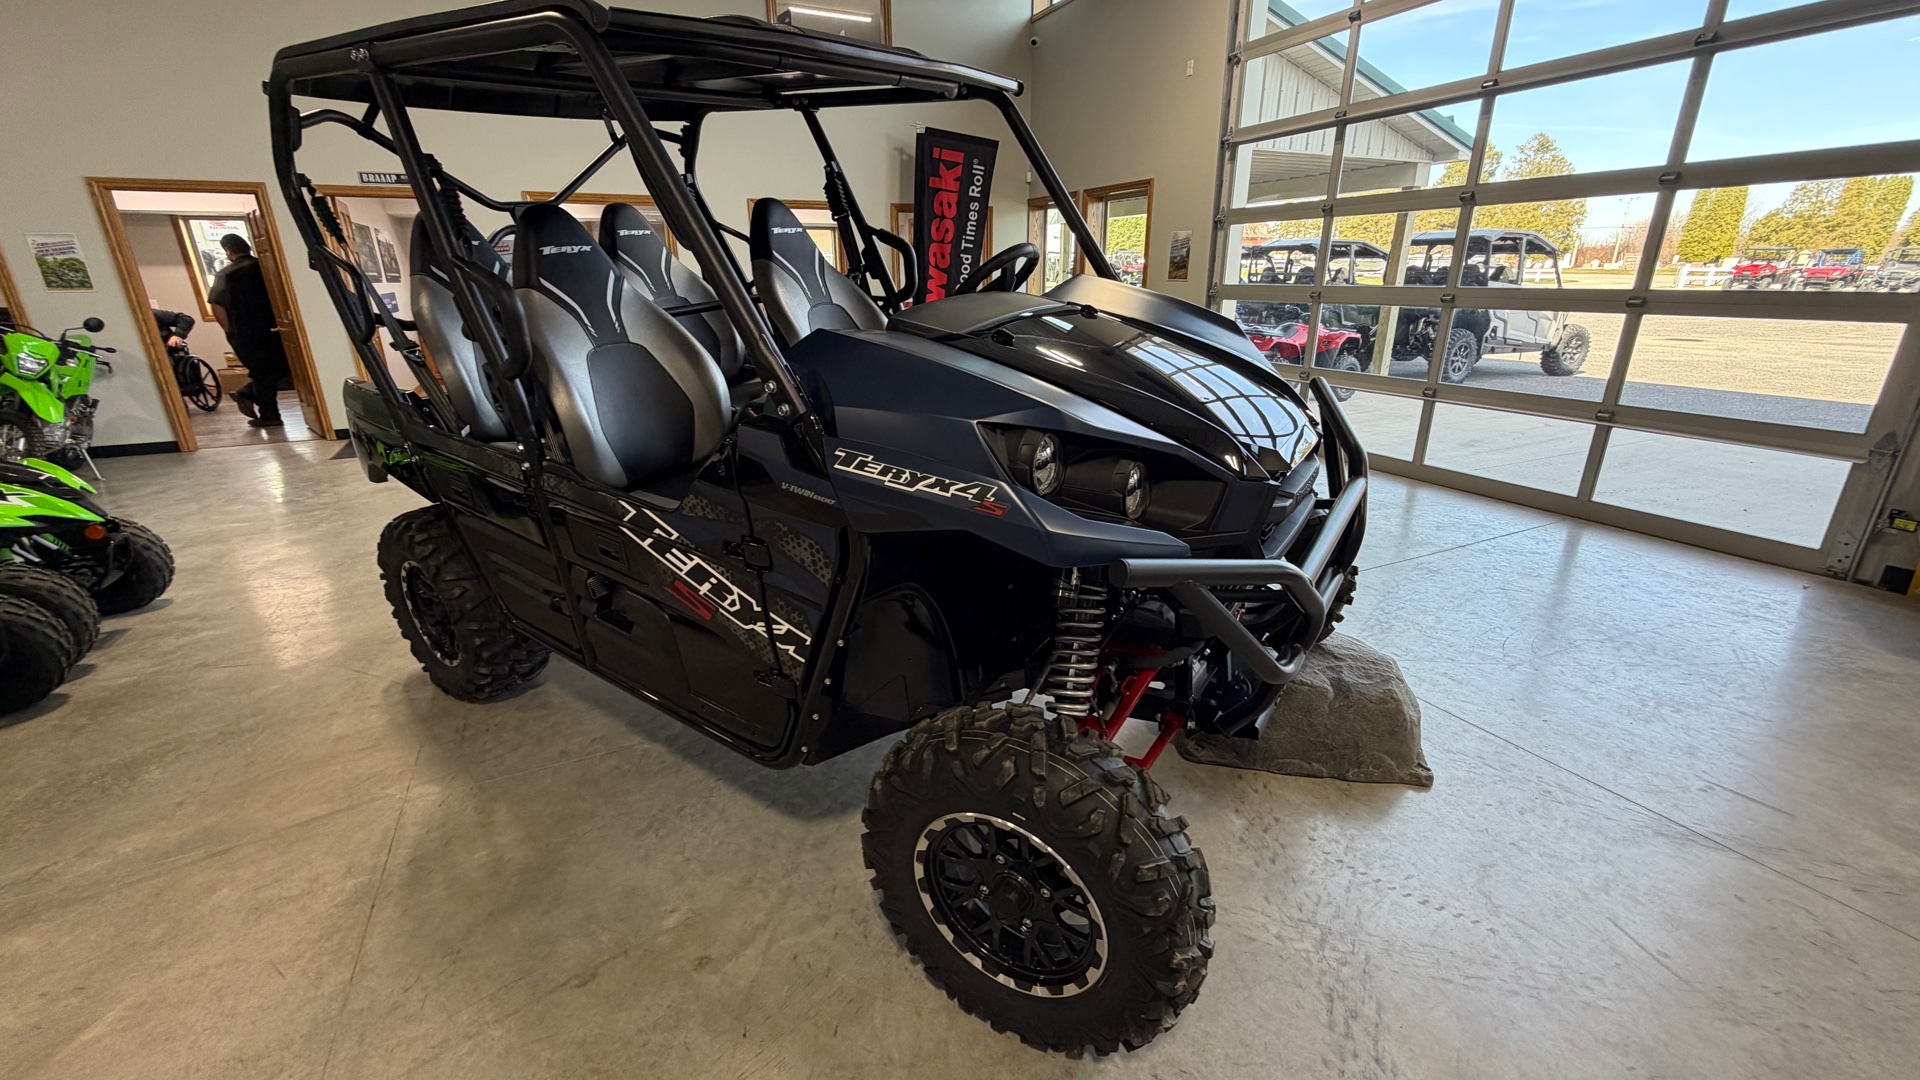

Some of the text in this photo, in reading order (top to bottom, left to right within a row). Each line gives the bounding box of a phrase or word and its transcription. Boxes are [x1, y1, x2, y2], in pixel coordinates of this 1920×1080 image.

[361, 173, 398, 183] BRAAAP
[771, 226, 804, 234] TERYX
[961, 202, 980, 250] Times
[539, 245, 593, 256] TERYX
[956, 254, 973, 292] ood
[833, 447, 999, 503] TERYX4
